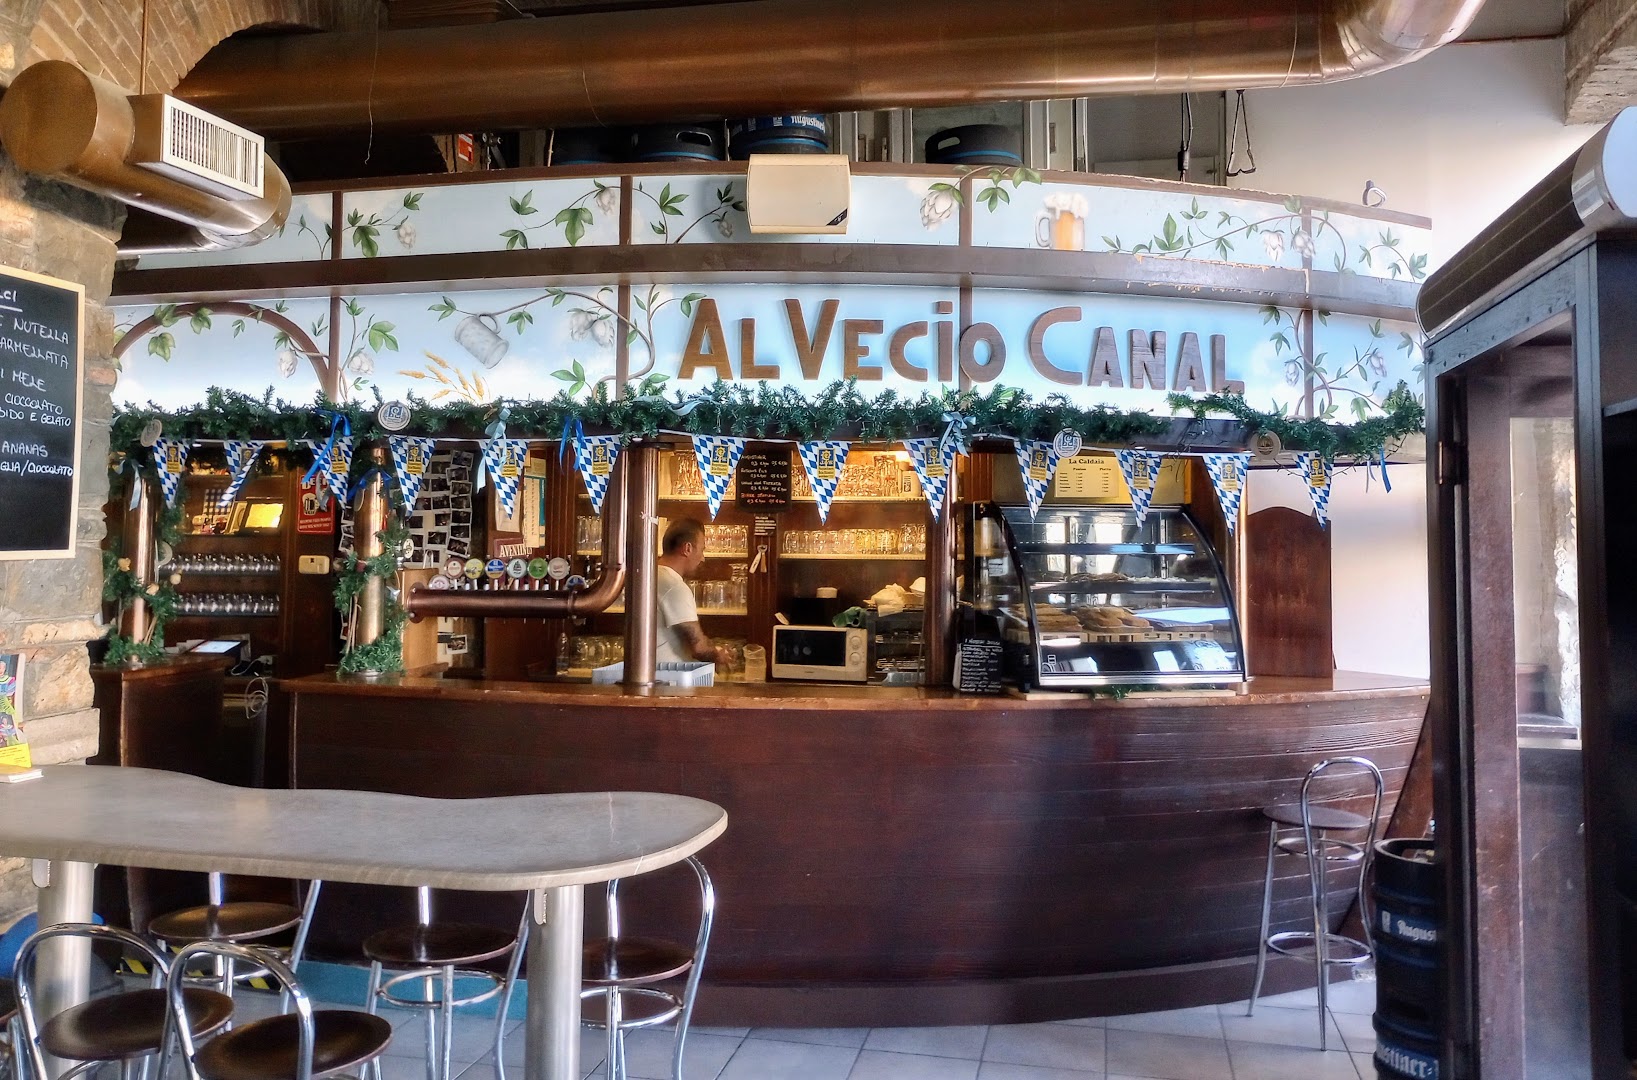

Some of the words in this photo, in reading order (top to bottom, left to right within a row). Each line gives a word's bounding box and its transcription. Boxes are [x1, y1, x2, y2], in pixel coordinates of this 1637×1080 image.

[13, 318, 69, 345] NUTELLA
[677, 298, 780, 381] AL
[1027, 306, 1245, 395] CANAL
[12, 370, 47, 392] MELE
[5, 392, 63, 415] CIOCCOLATO
[30, 412, 38, 422] E
[41, 413, 72, 427] GELATO
[2, 440, 49, 458] ANANAS
